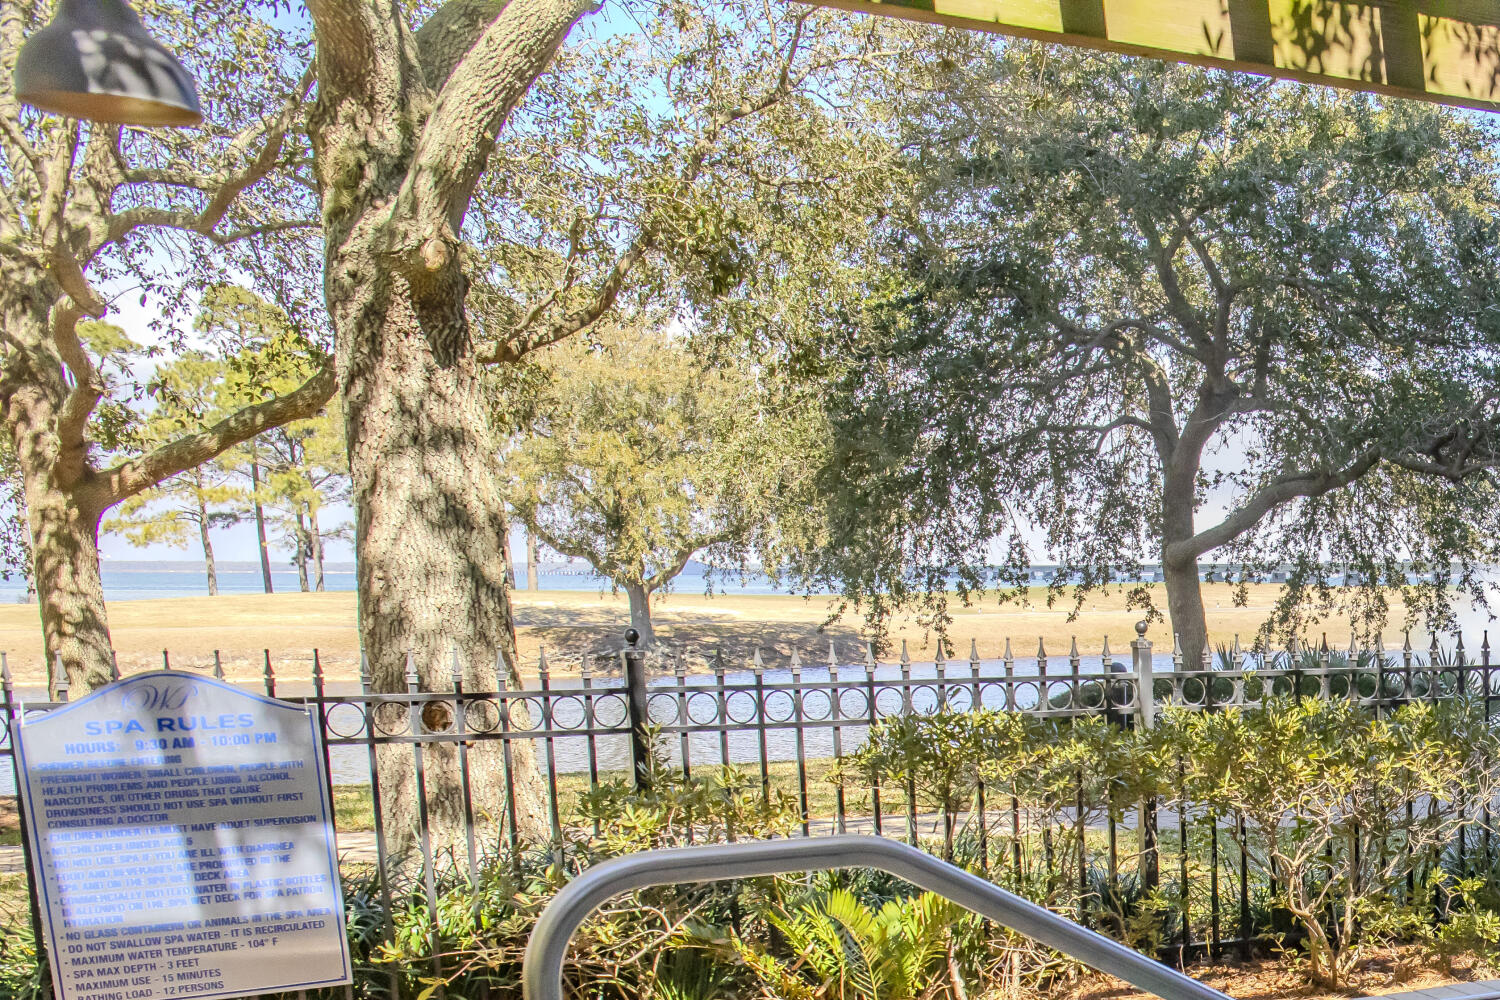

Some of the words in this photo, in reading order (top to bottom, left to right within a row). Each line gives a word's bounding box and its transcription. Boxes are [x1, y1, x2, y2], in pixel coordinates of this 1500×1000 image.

[84, 719, 144, 735] SPA
[157, 713, 254, 731] RULES
[64, 741, 120, 755] HOURS:
[135, 738, 167, 750] 9:30
[171, 737, 195, 748] AM
[212, 733, 249, 746] 10:00
[254, 732, 276, 743] PM
[147, 768, 181, 777] SMALL
[278, 760, 303, 769] WITH
[42, 785, 82, 796] HEALTH
[86, 781, 143, 793] PROBLEMS
[145, 780, 167, 789] AND
[170, 777, 208, 787] PEOPLE
[211, 775, 241, 784] USING
[110, 794, 124, 803] OR
[127, 791, 161, 801] OTHER
[164, 788, 199, 799] DRUGS
[201, 786, 226, 796] THAT
[229, 784, 261, 794] CAUSE
[45, 805, 116, 818] DROWSINESS
[119, 802, 160, 813] SHOULD
[163, 800, 182, 809] NOT
[186, 799, 206, 808] USE
[208, 797, 227, 806] SPA
[230, 794, 273, 805] WITHOUT
[277, 792, 304, 801] FIRST
[47, 816, 113, 829] CONSULTING
[116, 816, 124, 824] A
[127, 812, 168, 823] DOCTOR
[191, 822, 216, 831] HAVE
[219, 819, 249, 829] ADULT
[253, 814, 316, 826] SUPERVISION
[200, 848, 214, 856] ILL
[194, 871, 220, 881] DECK
[193, 883, 227, 893] WATER
[215, 893, 240, 902] DECK
[65, 932, 81, 941] NO
[84, 928, 117, 939] GLASS
[187, 920, 201, 929] OR
[204, 916, 248, 927] ANIMALS
[285, 910, 303, 919] SPA
[68, 944, 82, 953] DO
[86, 942, 107, 951] NOT
[109, 936, 161, 949] SWALLOW
[164, 934, 183, 943] SPA
[186, 931, 220, 941] WATER
[231, 929, 239, 937] IT
[243, 927, 252, 935] IS
[255, 920, 324, 934] RECIRCULATED
[71, 953, 124, 966] MAXIMUM
[127, 949, 162, 960] WATER
[165, 942, 237, 956] TEMPERATURE
[272, 937, 278, 945] F
[73, 969, 93, 979] SPA
[96, 966, 120, 976] MAX
[123, 963, 156, 973] DEPTH
[167, 961, 173, 969] 3
[176, 958, 200, 968] FEET
[75, 978, 128, 992] MAXIMUM
[131, 976, 151, 985] USE
[162, 974, 174, 982] 15
[176, 968, 221, 981] MINUTES
[125, 988, 152, 999] LOAD
[164, 986, 175, 994] 12
[178, 981, 224, 993] PERSONS
